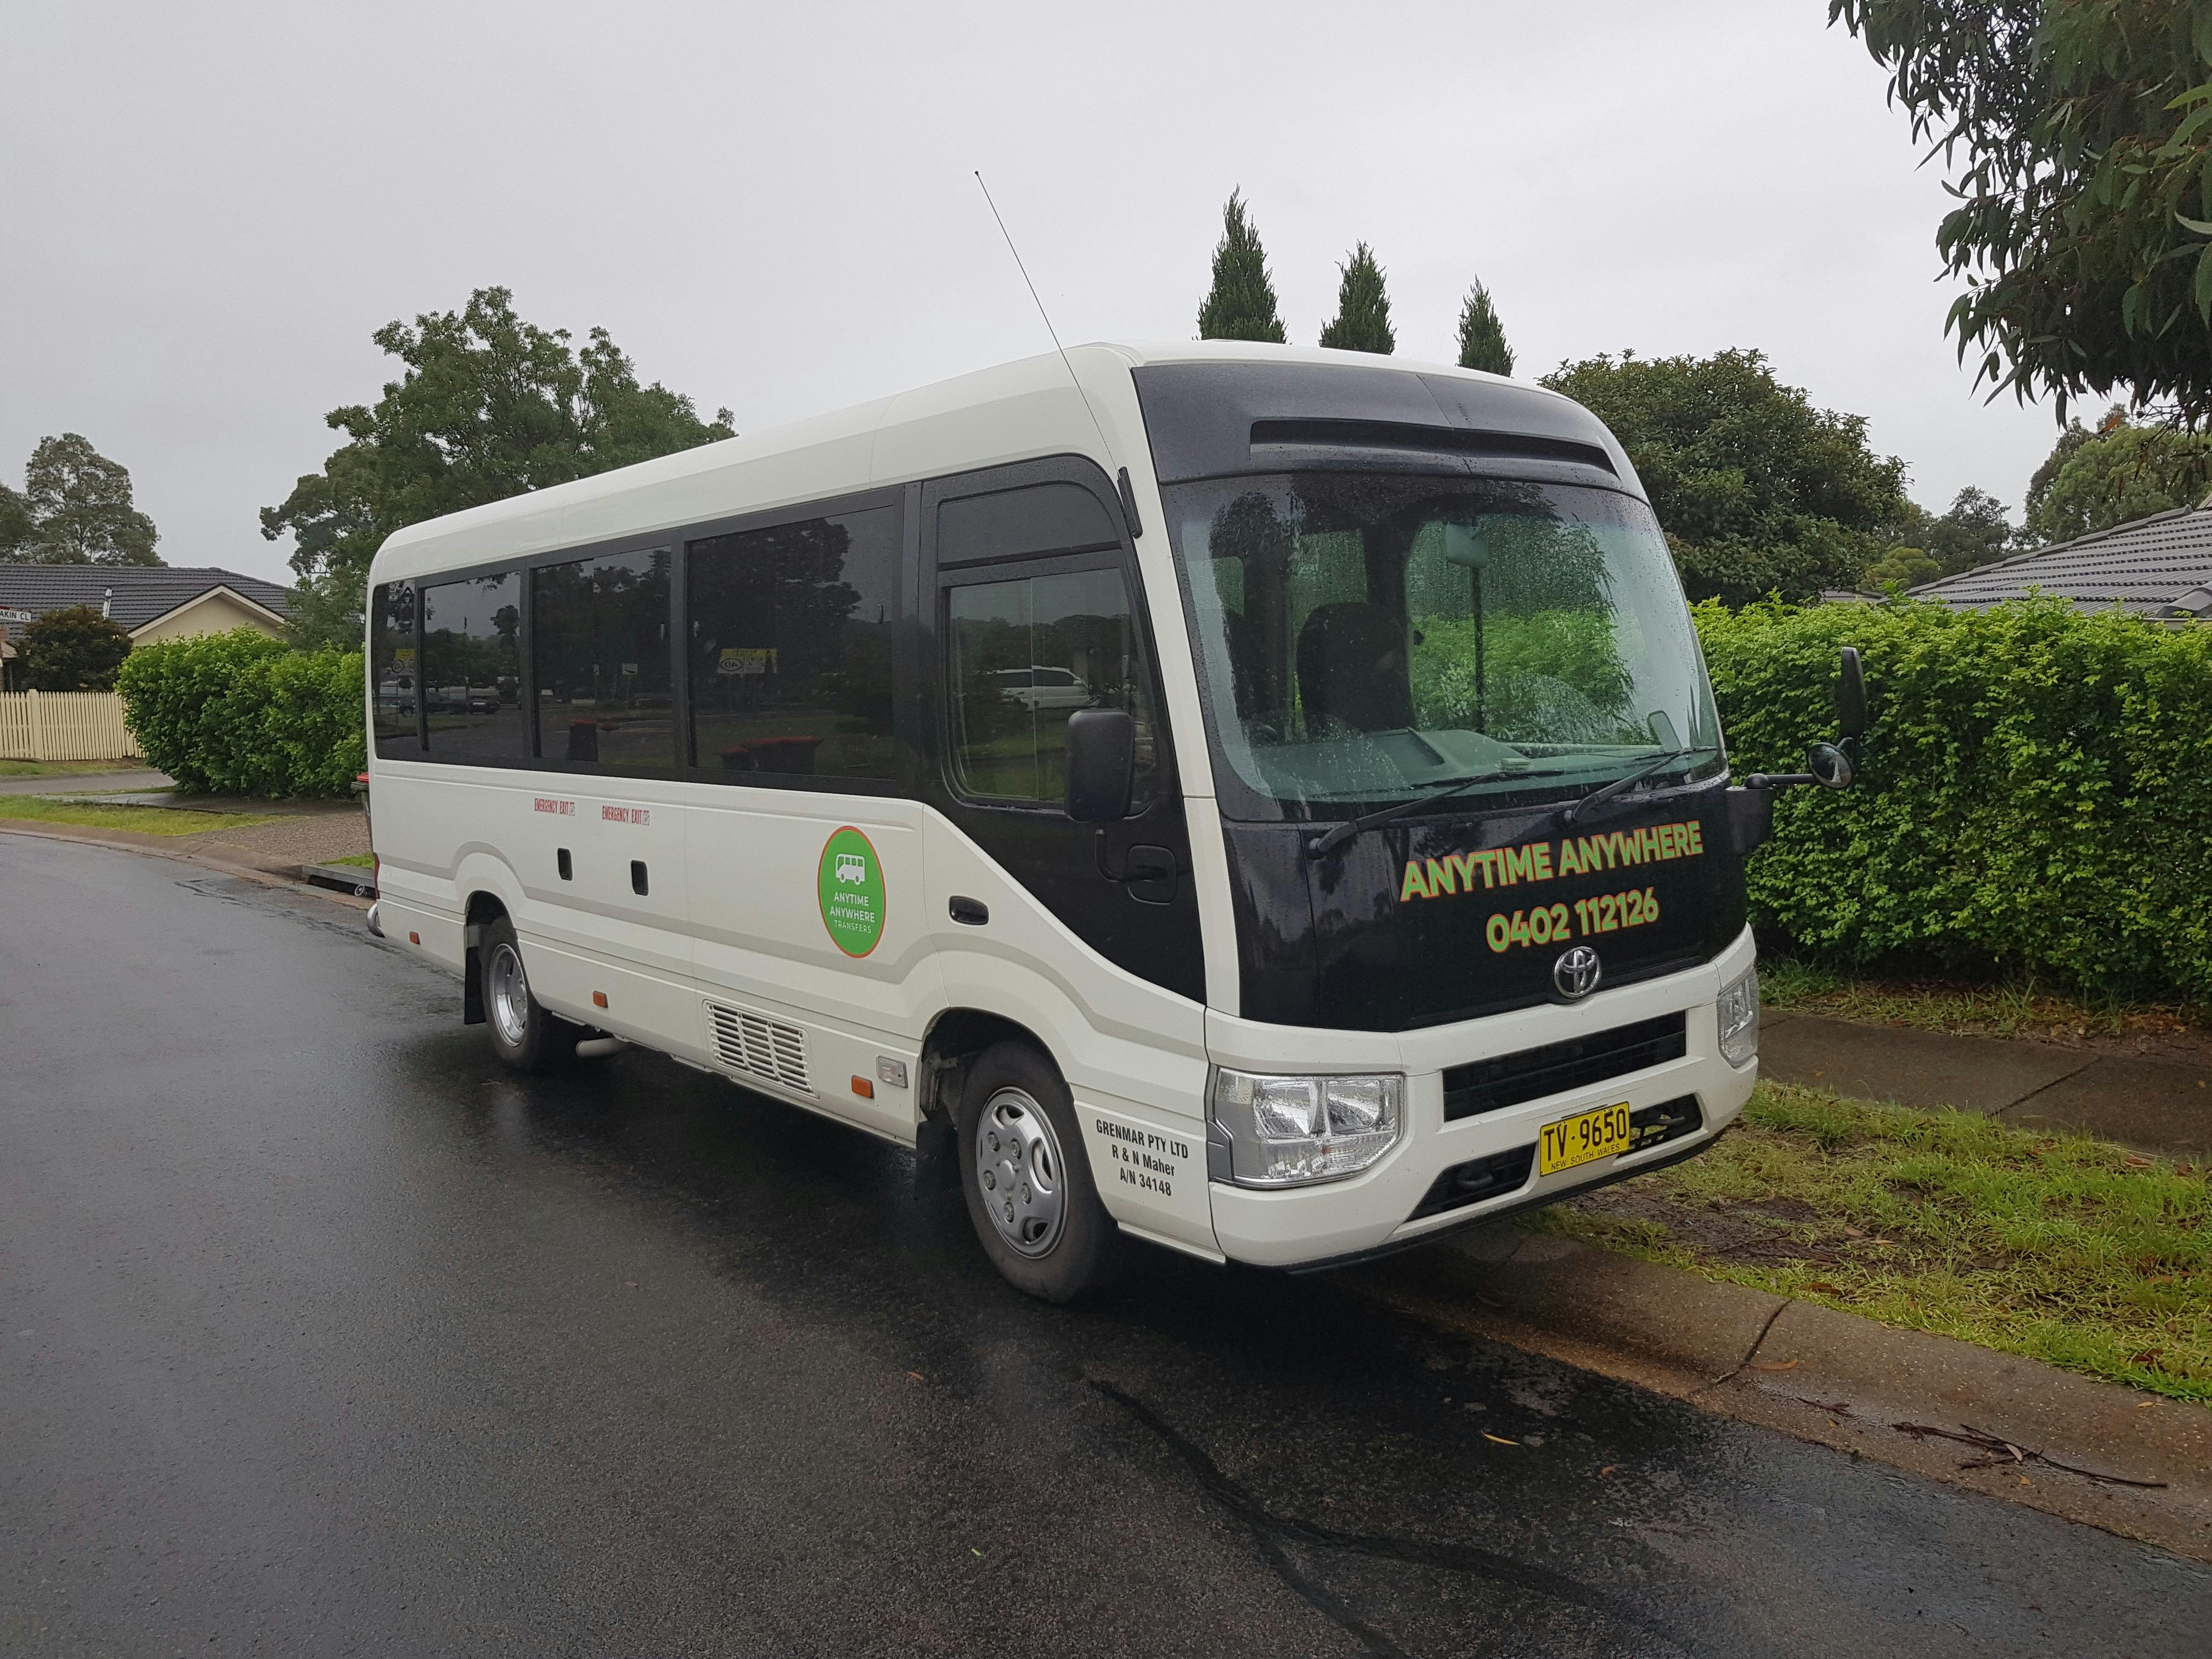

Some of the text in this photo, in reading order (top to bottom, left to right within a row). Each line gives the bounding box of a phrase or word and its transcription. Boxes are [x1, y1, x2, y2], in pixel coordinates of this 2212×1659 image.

[20, 612, 29, 620] CL
[535, 798, 568, 815] EMERGENCY EXIT
[602, 806, 641, 824] EMERGENCY EXIT
[1400, 821, 1703, 902] ANYTIME ANYWHERE
[834, 891, 869, 906] ANYTIME
[830, 906, 875, 922] ANYWHERE
[1486, 887, 1660, 953] 0402 112126
[834, 920, 871, 933] TRANSFERS
[1096, 1119, 1188, 1158] GRENMAR PTY LTD
[1112, 1144, 1175, 1176] R & N Maher
[1551, 1143, 1620, 1170] NEW SOUTH WALES
[1120, 1167, 1172, 1196] A/N 34148
